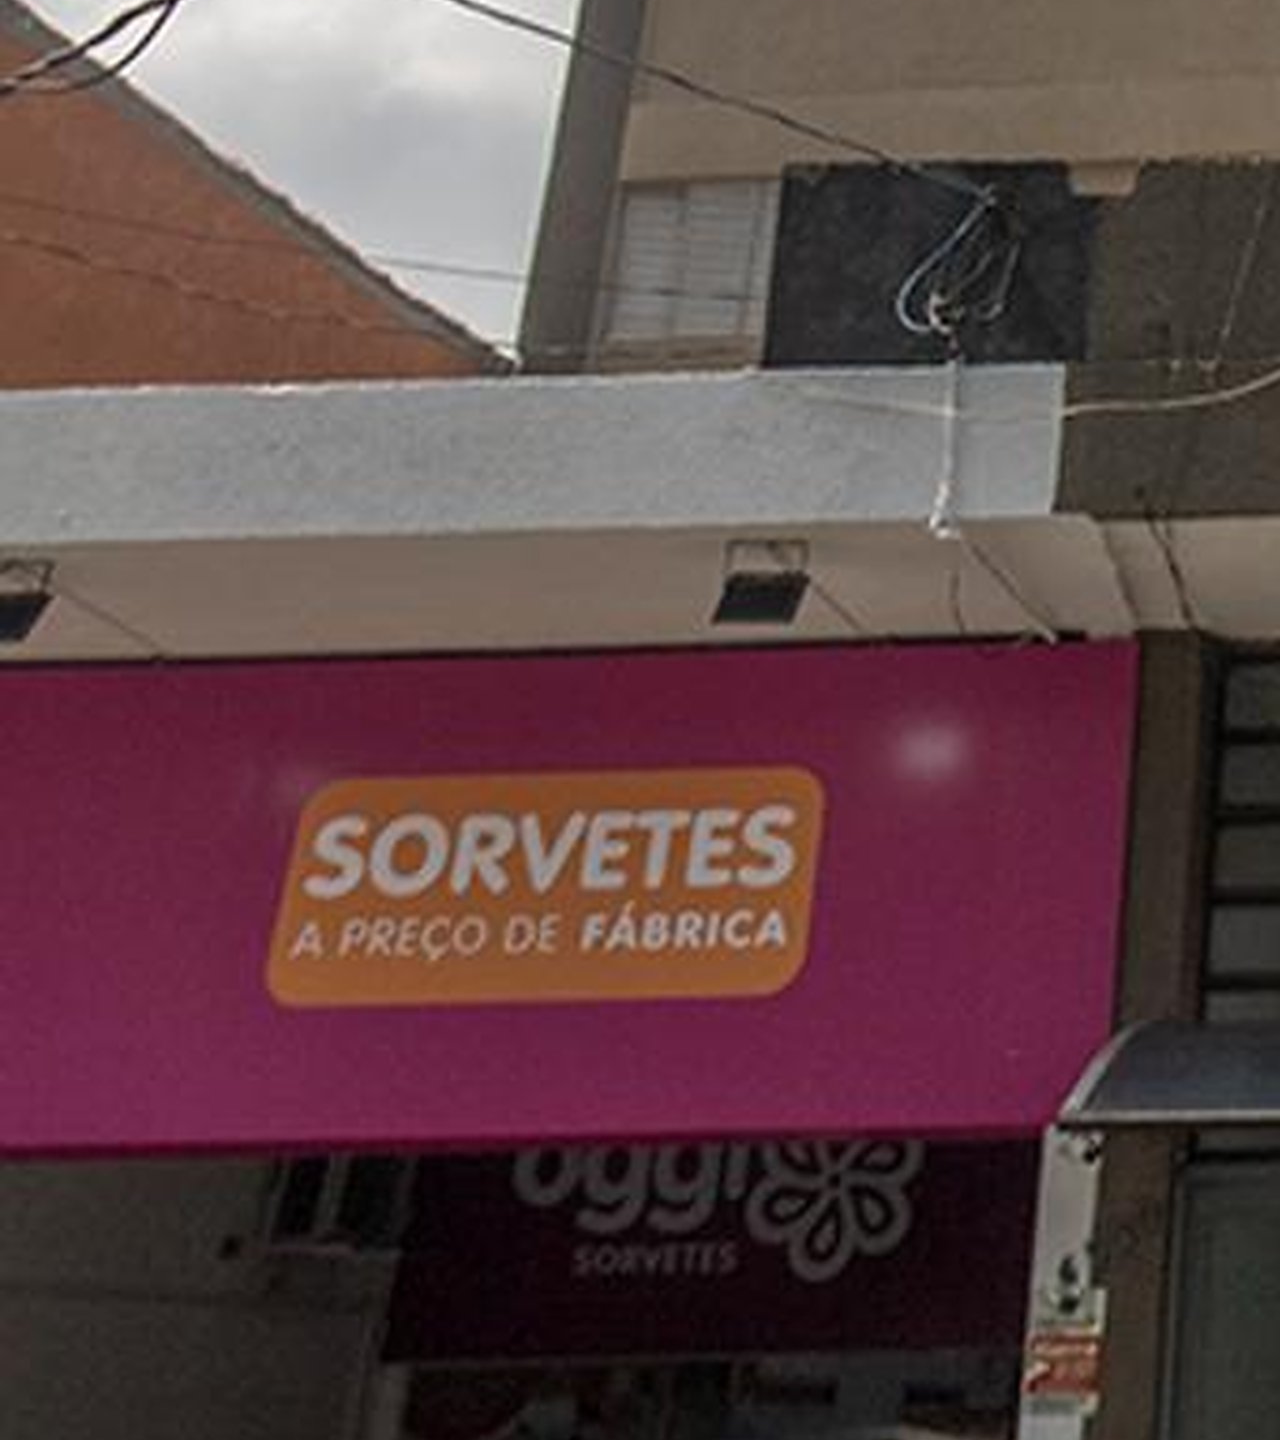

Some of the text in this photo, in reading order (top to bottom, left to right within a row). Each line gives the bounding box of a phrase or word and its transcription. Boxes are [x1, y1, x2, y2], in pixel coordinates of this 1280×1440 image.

[303, 804, 798, 899] SORVETES
[289, 900, 788, 962] A PREÇO DE FÁBRICA
[571, 1241, 741, 1277] SORVETES
